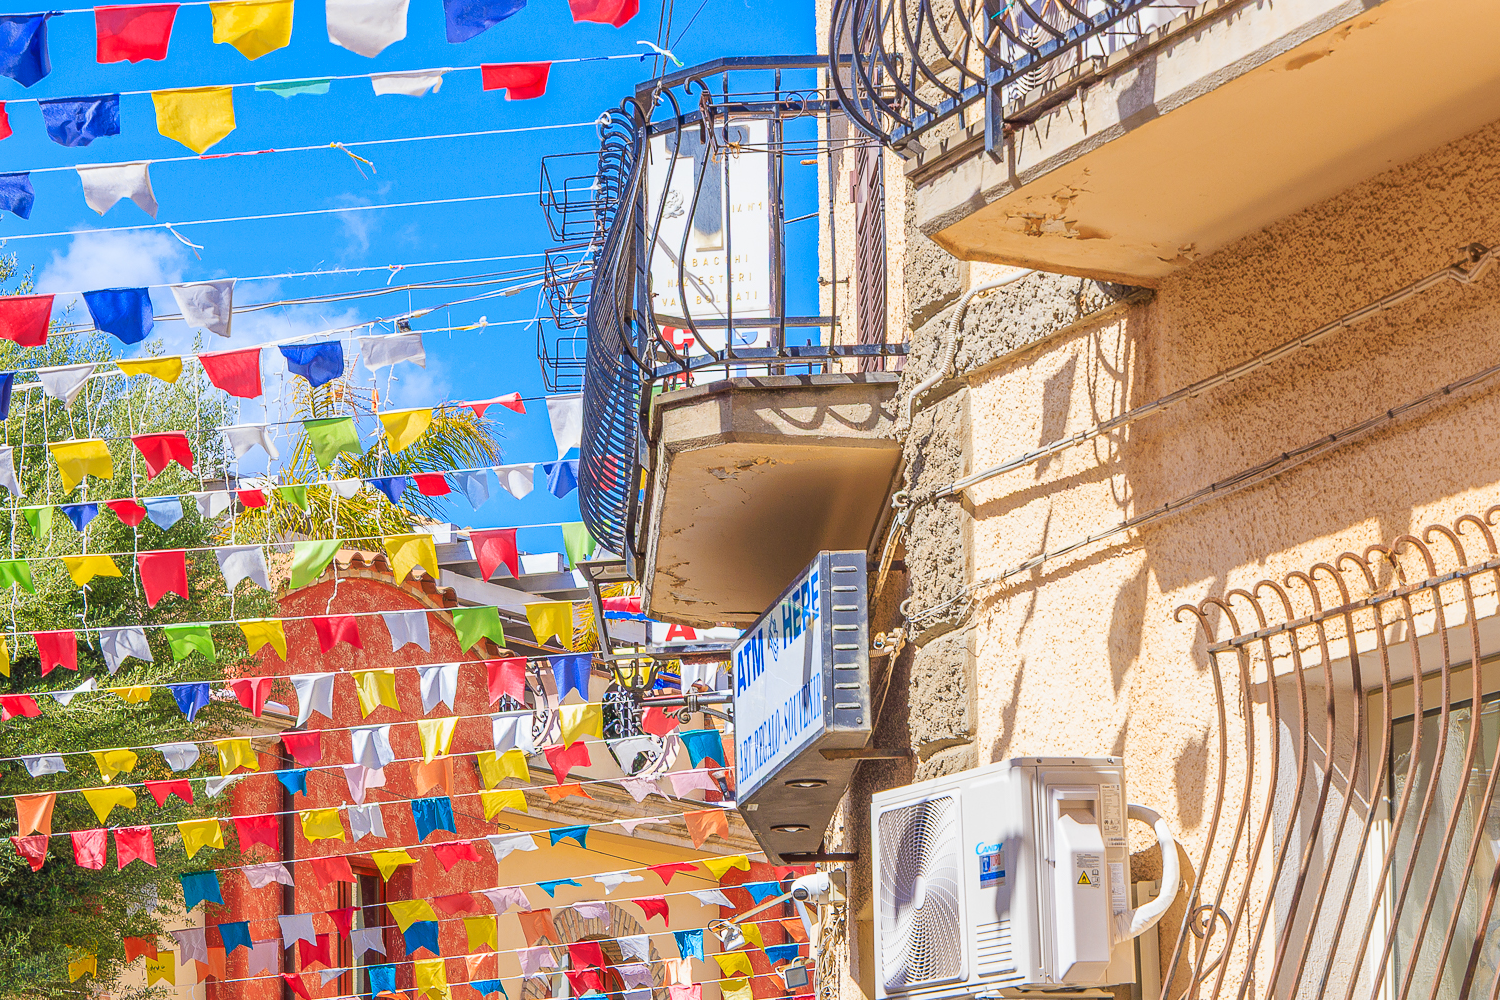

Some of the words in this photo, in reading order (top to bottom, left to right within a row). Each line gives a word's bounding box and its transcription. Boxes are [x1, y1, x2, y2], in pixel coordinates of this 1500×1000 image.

[699, 272, 752, 286] ESTERI
[737, 627, 764, 698] ATM
[782, 570, 820, 650] HERE
